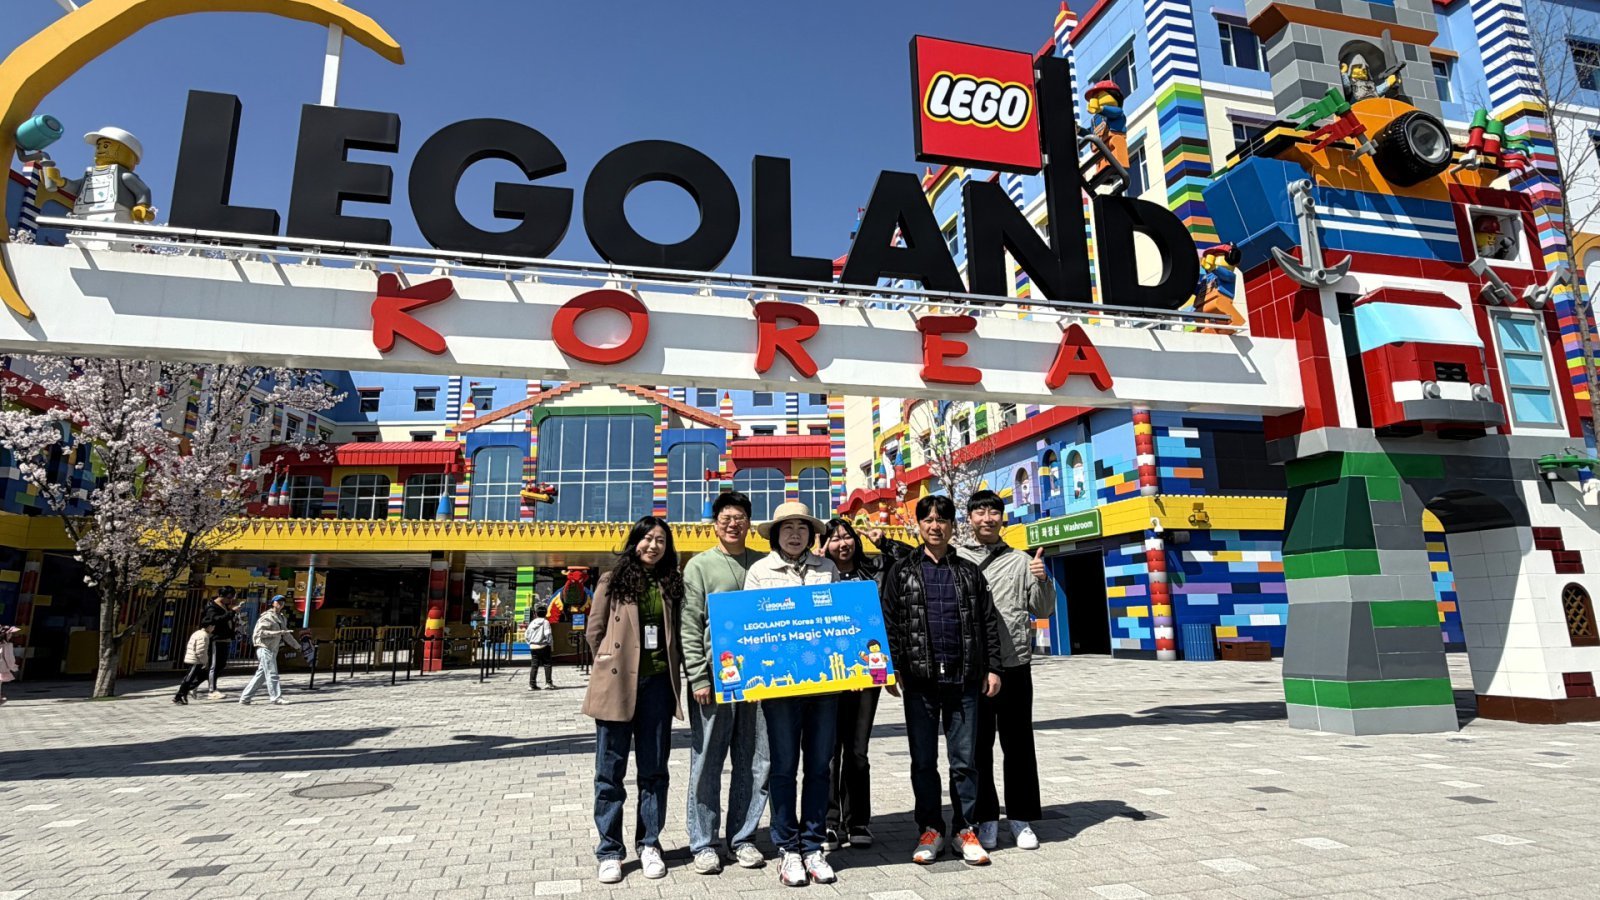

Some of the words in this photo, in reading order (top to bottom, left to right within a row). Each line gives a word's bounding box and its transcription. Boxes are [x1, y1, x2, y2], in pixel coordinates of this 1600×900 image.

[925, 73, 1030, 130] LEGO
[169, 55, 1200, 311] LEGOLAND
[371, 272, 1112, 391] KOREA
[1042, 525, 1060, 537] 화장실
[1063, 521, 1093, 532] Washroom
[737, 633, 786, 644] <Merlin's
[789, 629, 821, 641] Magic
[823, 625, 861, 636] Wand>
[792, 618, 815, 626] Korea
